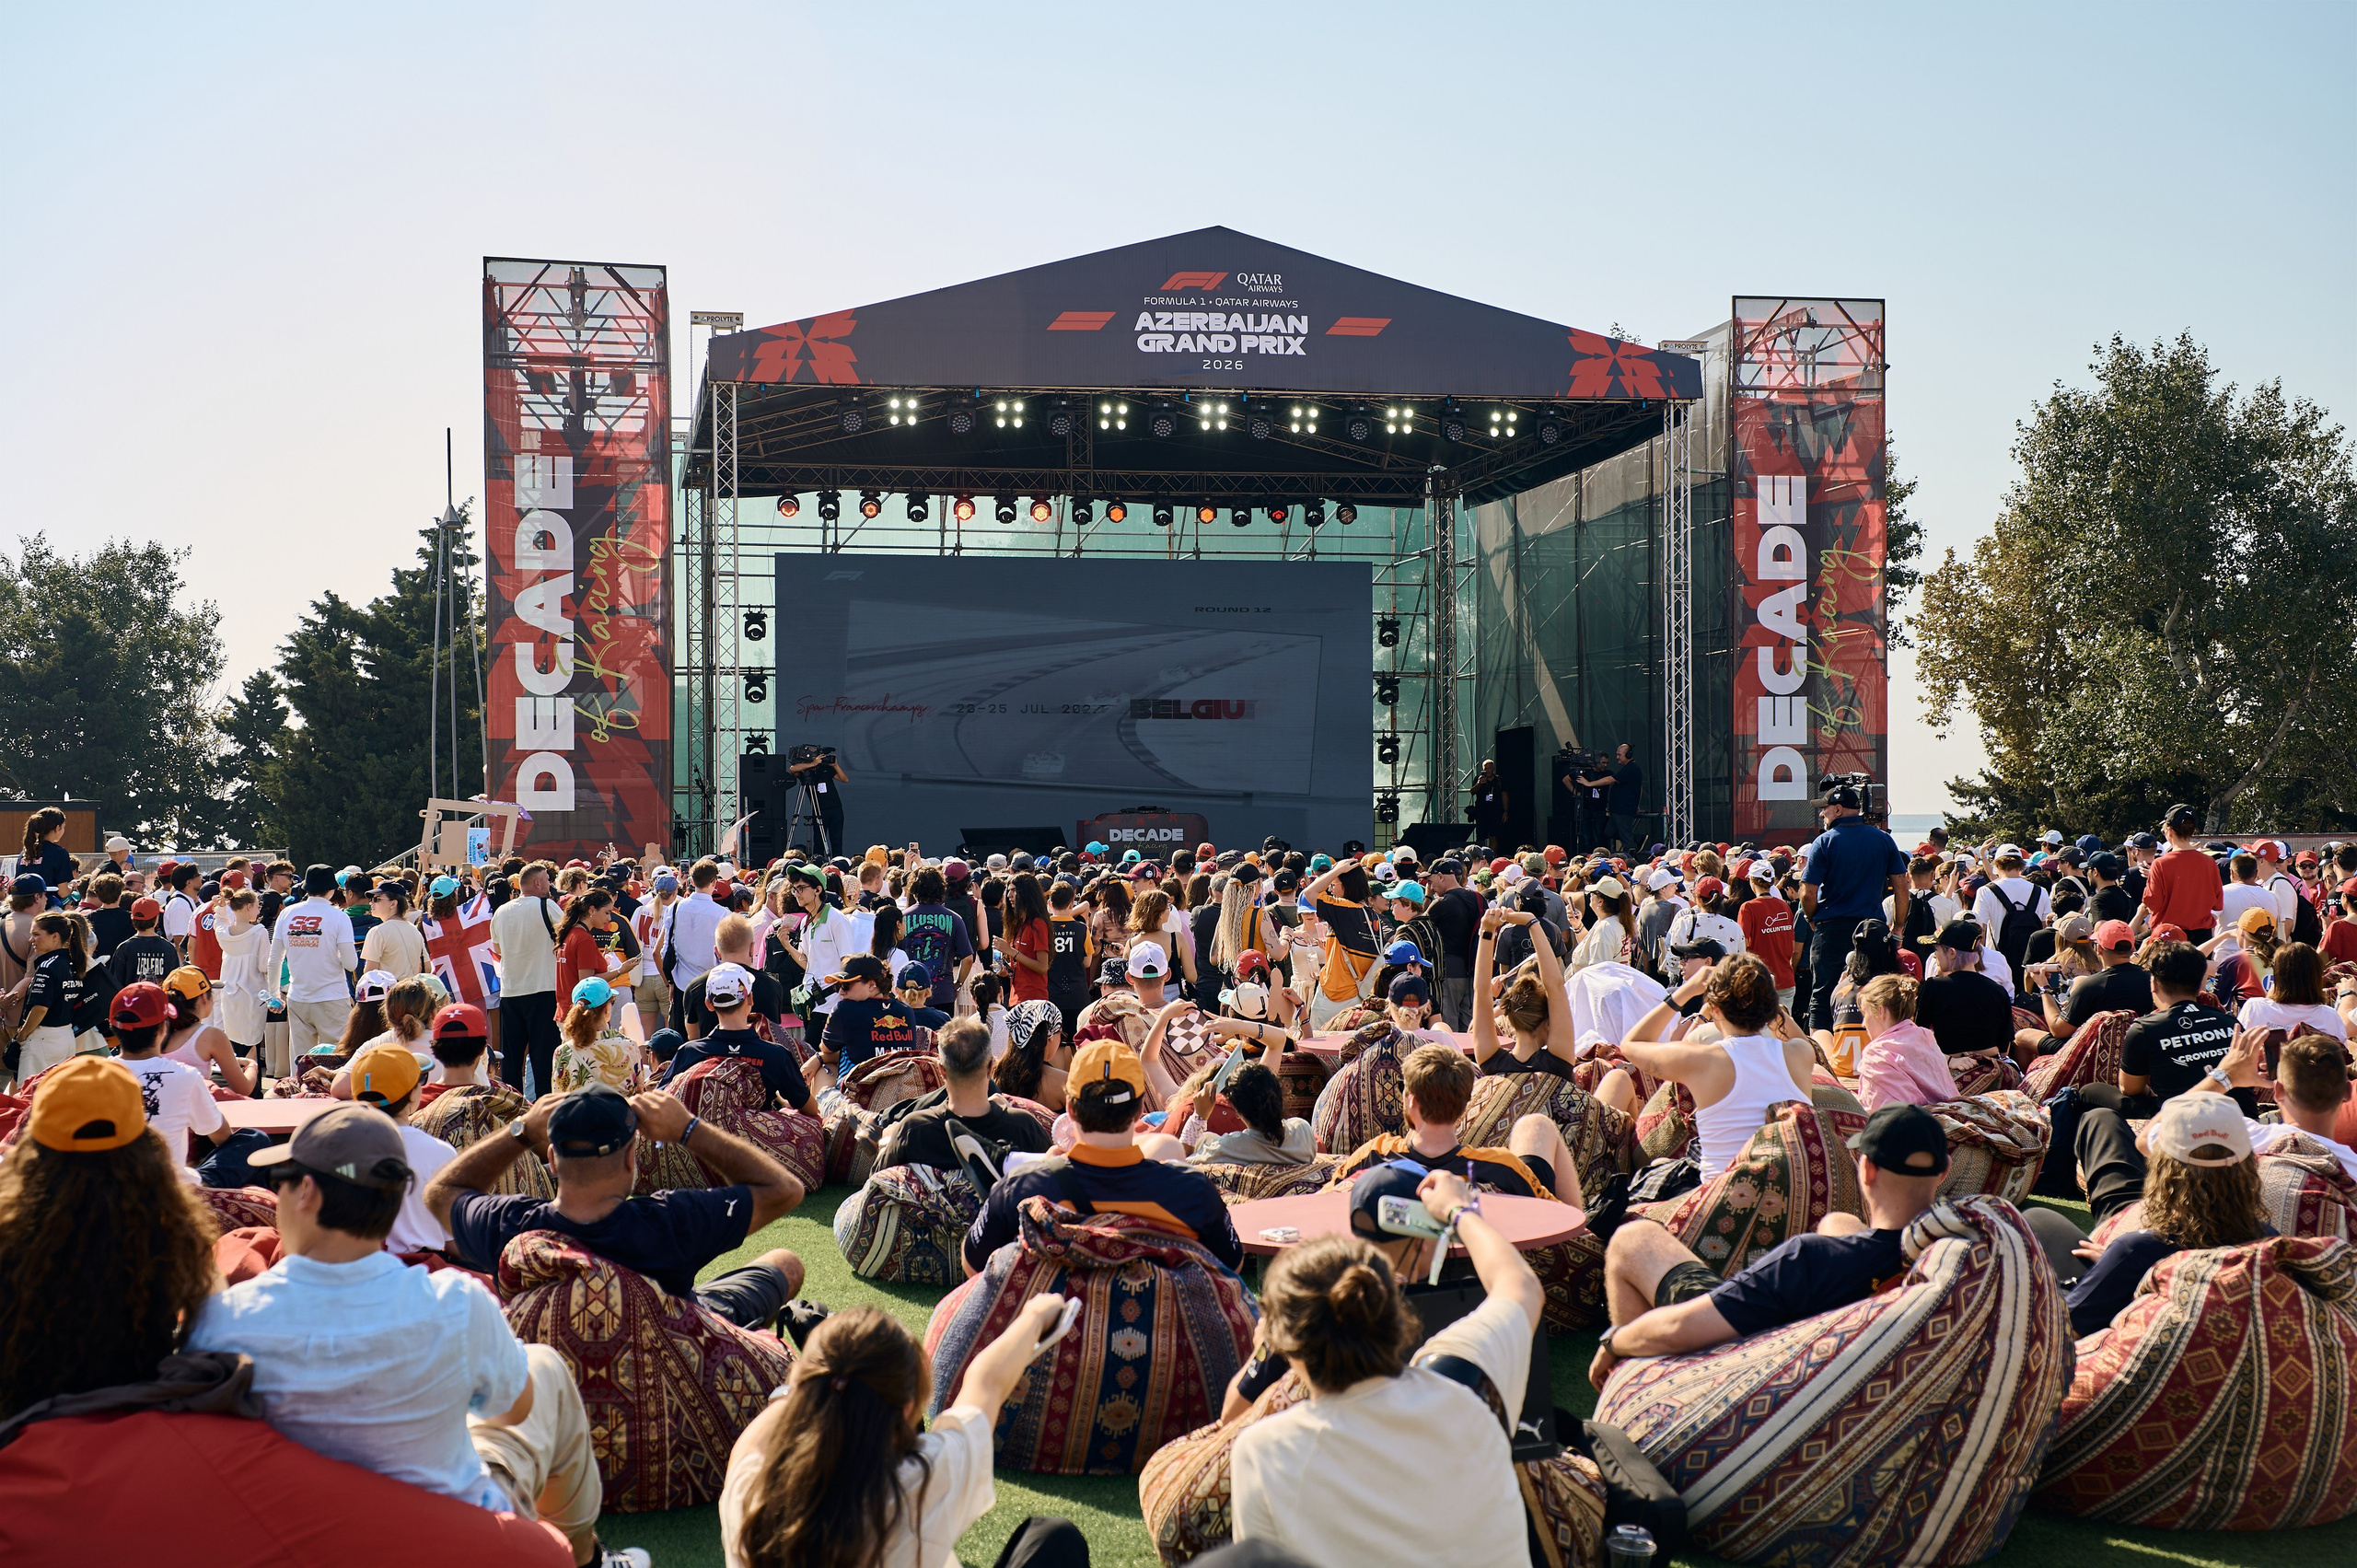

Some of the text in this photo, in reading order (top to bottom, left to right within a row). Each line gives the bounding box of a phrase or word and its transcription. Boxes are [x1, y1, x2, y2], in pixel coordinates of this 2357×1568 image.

[1237, 273, 1283, 286] QATAR
[1248, 285, 1283, 293] AIRWAYS
[1144, 296, 1299, 308] FORMULA 1 QATAR AIRWAYS
[1134, 311, 1309, 335] AZERBAIJAN
[1136, 332, 1306, 356] GRAND PRIX
[1202, 359, 1244, 370] 2026
[514, 454, 575, 812] DECADE
[552, 527, 660, 743] of Racing
[1757, 475, 1807, 801] DECADE
[1790, 538, 1880, 738] of Racing
[1020, 703, 1050, 714] JUL
[1109, 828, 1184, 842] DECADE
[288, 916, 322, 931] 33
[904, 913, 953, 937] ILLUSION
[1761, 925, 1793, 935] VOLUNTEER
[1054, 936, 1074, 953] 81
[871, 1028, 913, 1041] Red Bull
[2159, 1027, 2235, 1051] PETRONA
[2177, 1046, 2232, 1063] CROWDST
[2191, 1128, 2229, 1141] Red Bull
